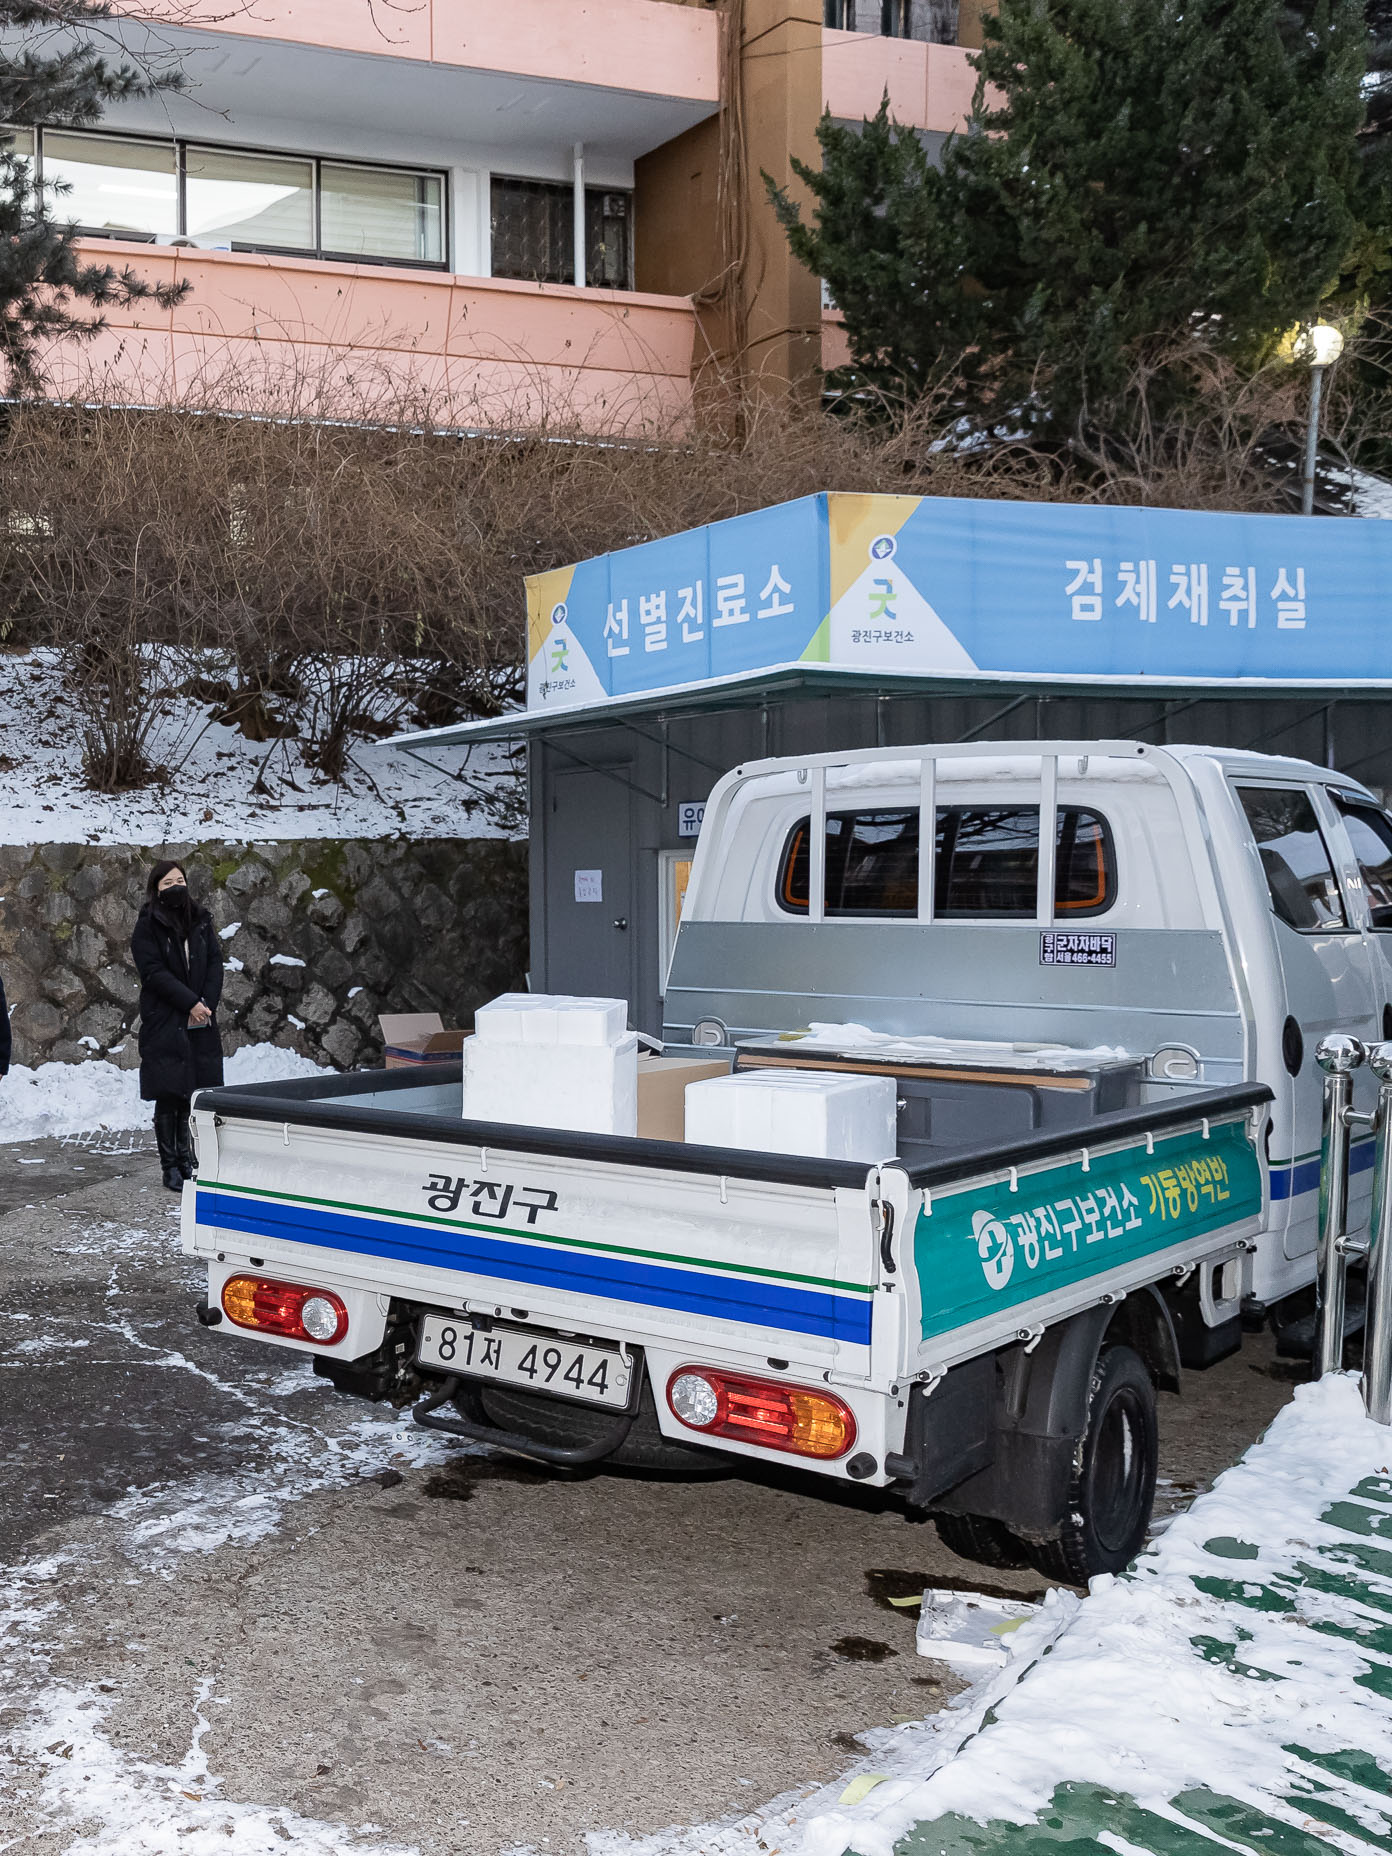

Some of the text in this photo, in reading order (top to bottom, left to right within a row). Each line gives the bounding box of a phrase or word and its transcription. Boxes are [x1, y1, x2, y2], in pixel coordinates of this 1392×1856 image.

[602, 563, 796, 659] 선별진료소
[1065, 558, 1307, 630] 검체채취실
[851, 630, 914, 644] 광진구보건소
[1057, 936, 1113, 952] 군자차바닥
[1057, 953, 1071, 962] 서울
[421, 1172, 560, 1225] 광진구
[1016, 1155, 1231, 1269] 광진구보건소 기동방역반
[438, 1326, 609, 1395] 81저 4944
